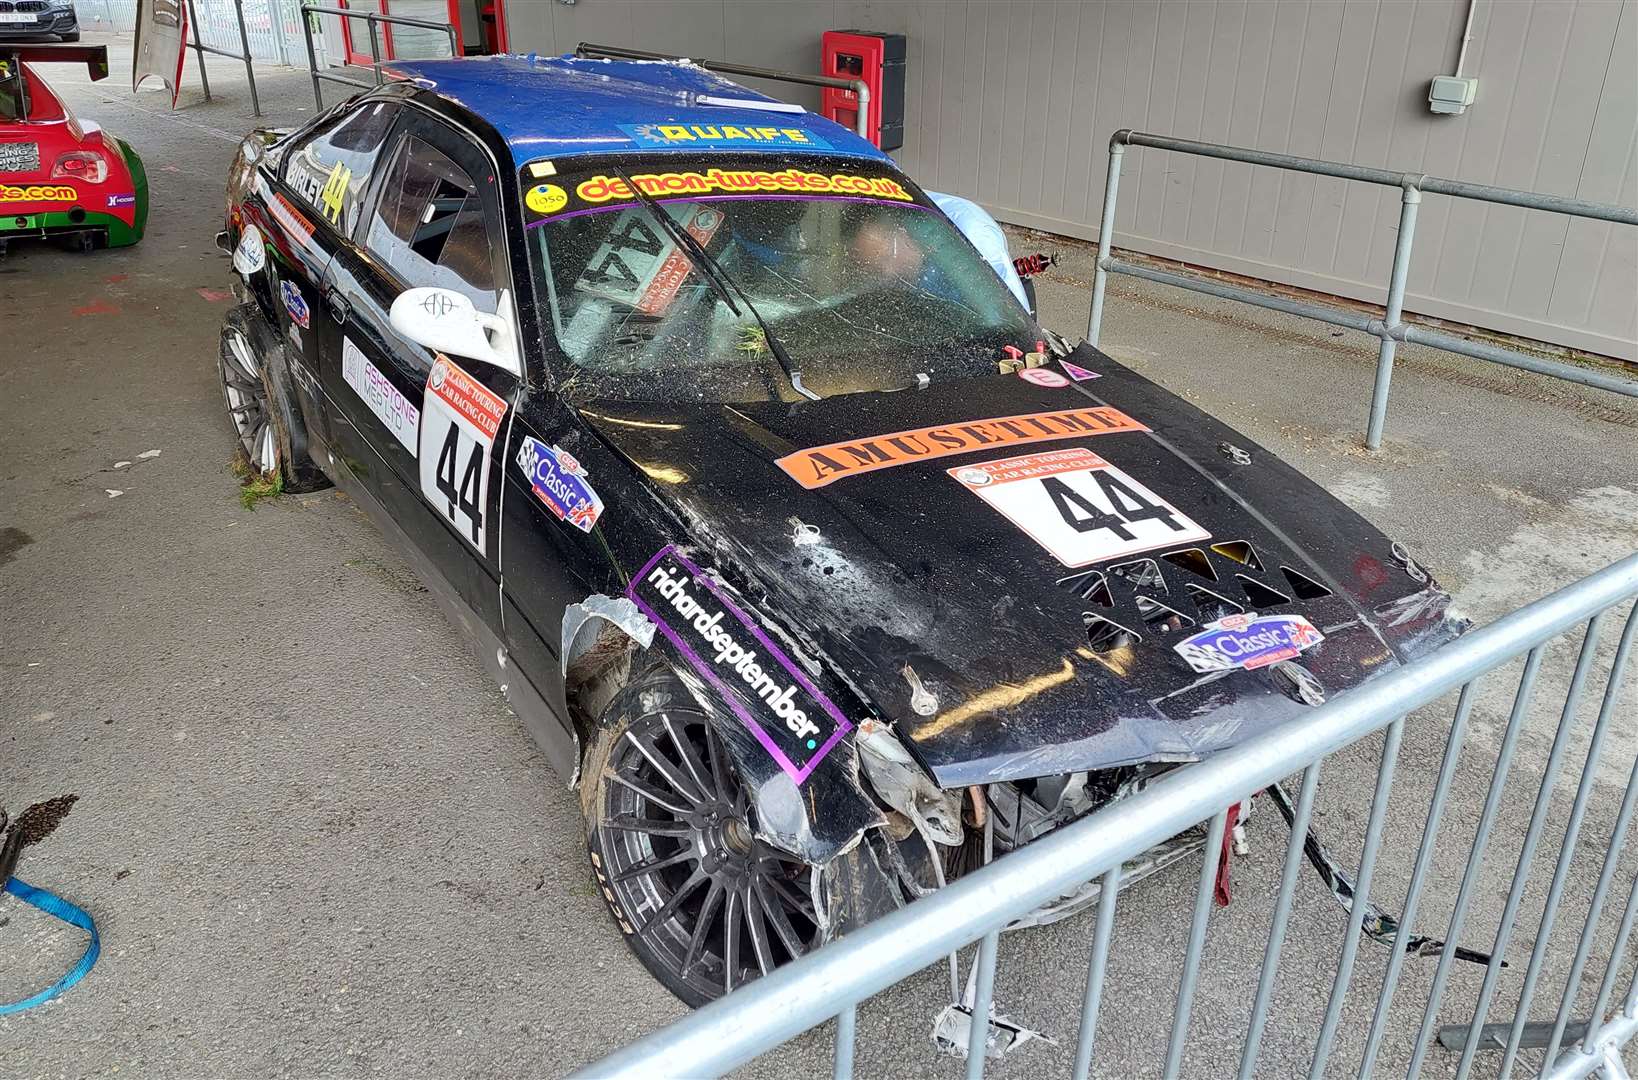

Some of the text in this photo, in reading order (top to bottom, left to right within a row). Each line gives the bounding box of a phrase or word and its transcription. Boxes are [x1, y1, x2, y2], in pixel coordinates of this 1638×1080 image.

[656, 125, 808, 143] QUAIFE
[286, 160, 324, 208] BIRLEY
[322, 160, 351, 225] 44
[577, 169, 911, 201] demon-tweeks.co.uk
[580, 214, 665, 294] 44
[364, 361, 417, 426] ASHSTONE
[364, 380, 383, 407] MEP
[384, 400, 402, 430] LTD
[440, 383, 497, 433] CAR RACING CLUB
[446, 367, 502, 418] CLASSIC TOURING
[814, 410, 1127, 481] AMUSETIME
[982, 451, 1092, 473] CLASSIC TOURING
[993, 458, 1102, 481] CAR RACING CLUB
[436, 420, 484, 546] 44
[536, 458, 577, 508] Classic
[1040, 469, 1188, 542] 44
[648, 566, 820, 750] richardseptember.
[1215, 627, 1290, 657] Classic
